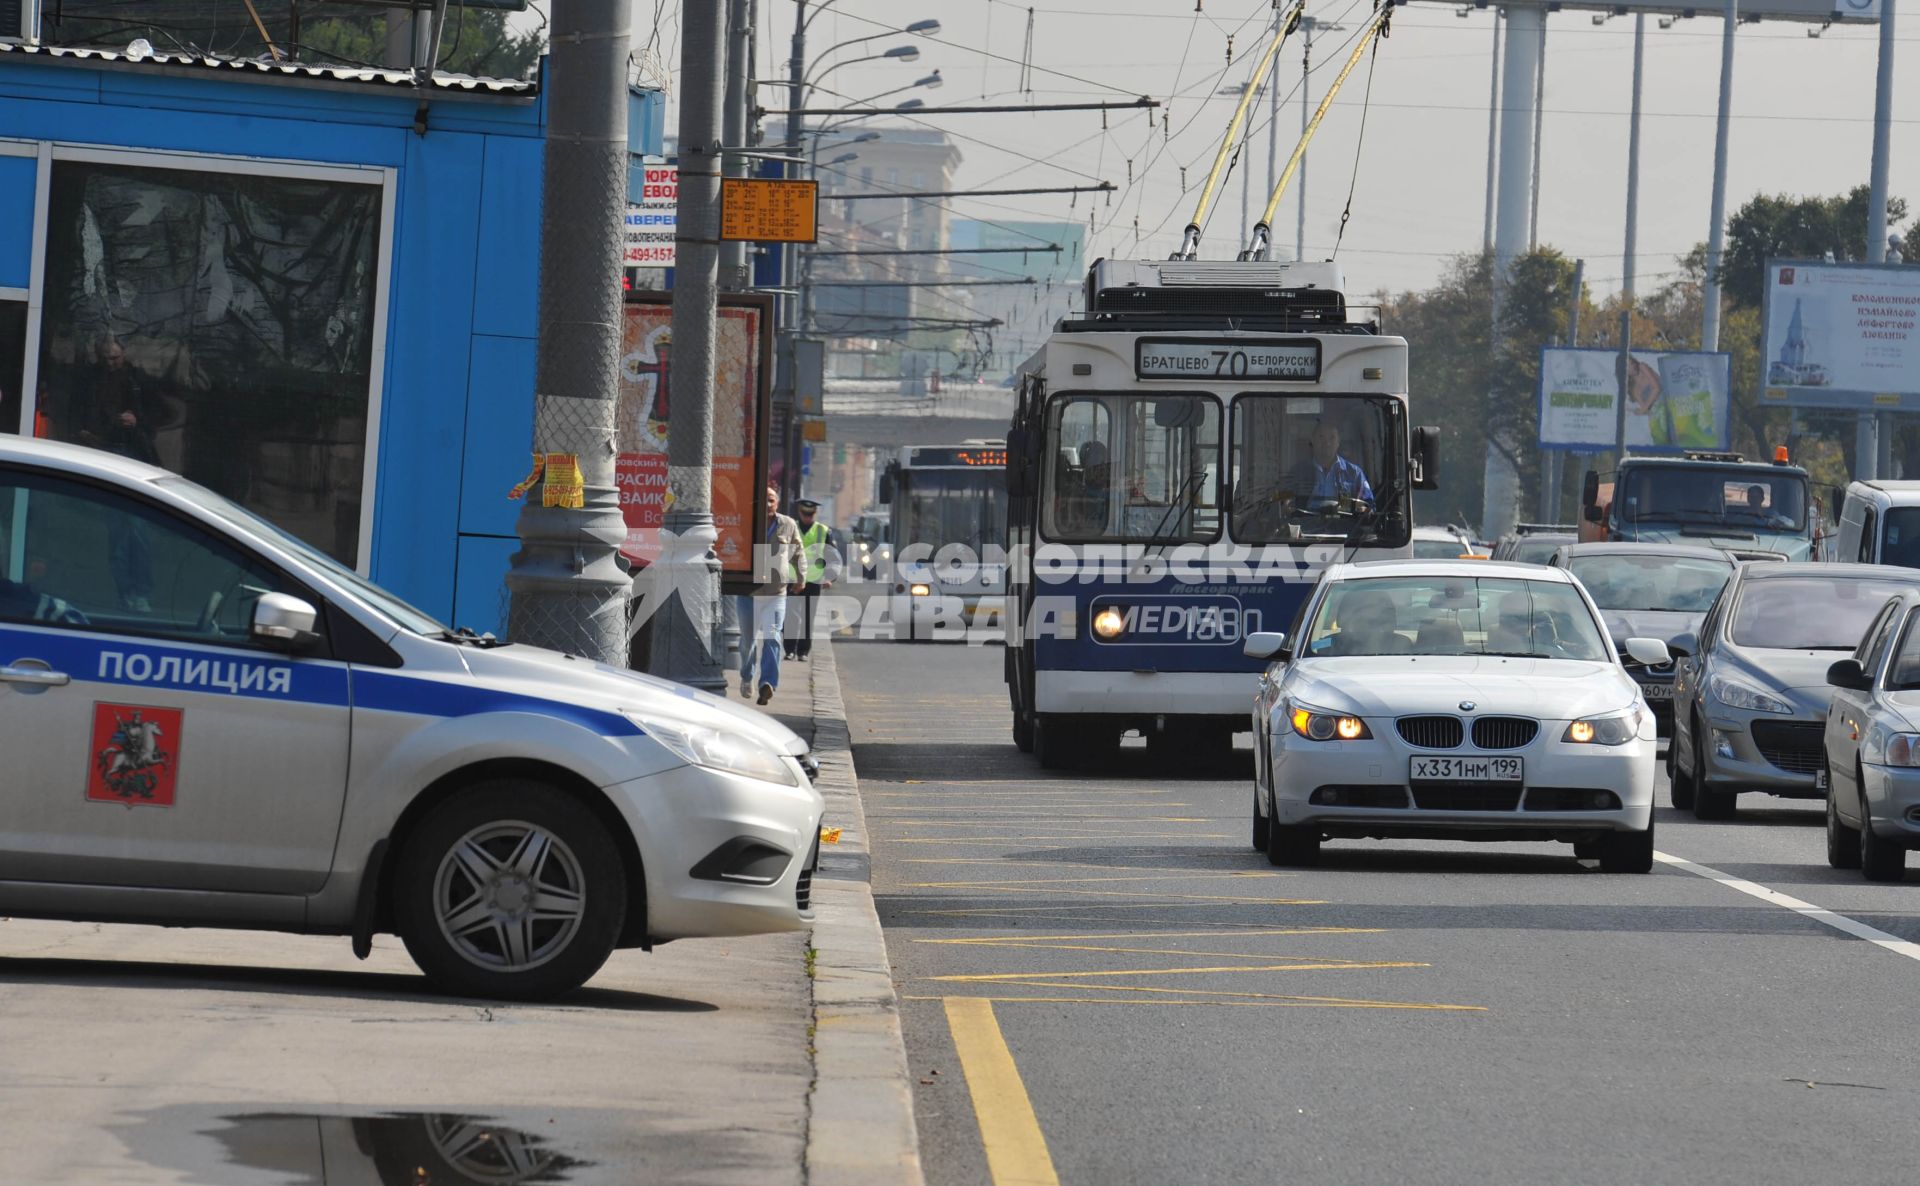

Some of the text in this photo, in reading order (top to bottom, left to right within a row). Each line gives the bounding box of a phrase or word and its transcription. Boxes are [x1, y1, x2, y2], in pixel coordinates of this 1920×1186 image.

[1143, 351, 1248, 376] БРАТЦЕВО 70
[1169, 583, 1275, 596] Мосгортранс
[98, 651, 292, 693] ПОЛИЦИЯ
[1491, 759, 1518, 773] 199
